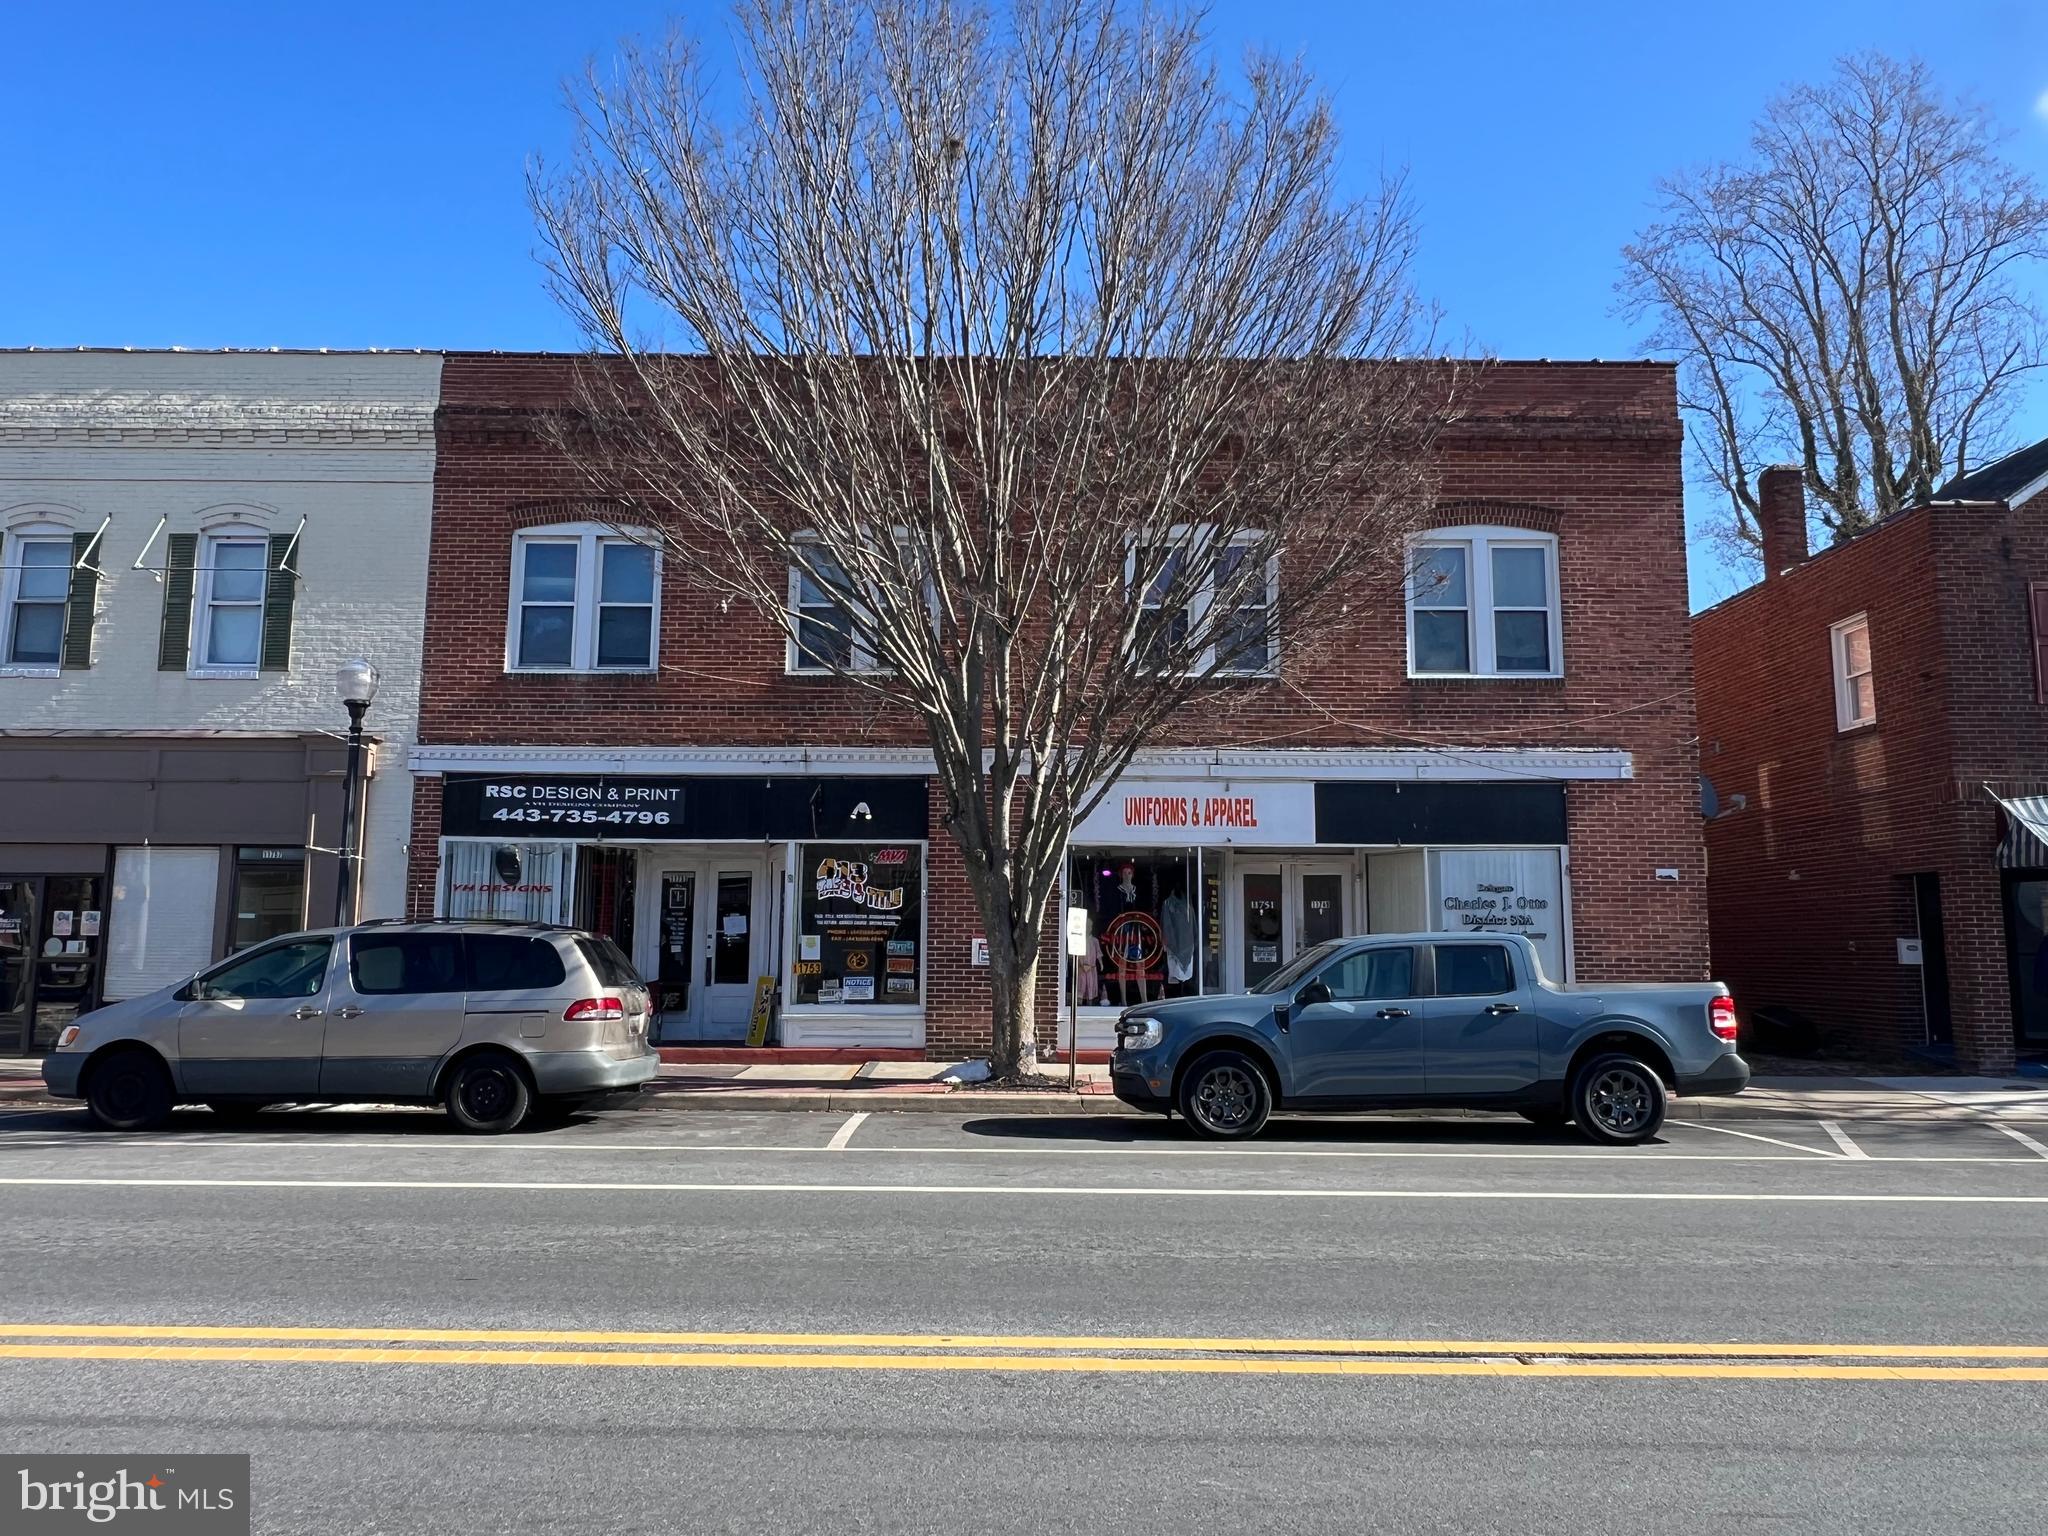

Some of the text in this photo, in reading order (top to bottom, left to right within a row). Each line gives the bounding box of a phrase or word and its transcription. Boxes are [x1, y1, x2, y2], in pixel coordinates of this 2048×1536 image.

[485, 785, 681, 801] RSC DESIGN & PRINT
[492, 808, 671, 825] 443-735-4796
[1124, 796, 1258, 828] UNIFORMS & APPAREL
[479, 883, 553, 893] DESIGNS
[1250, 901, 1275, 909] 11751
[1444, 896, 1549, 912] Charles J. Otto
[1462, 914, 1507, 926] District
[792, 962, 821, 976] 11753
